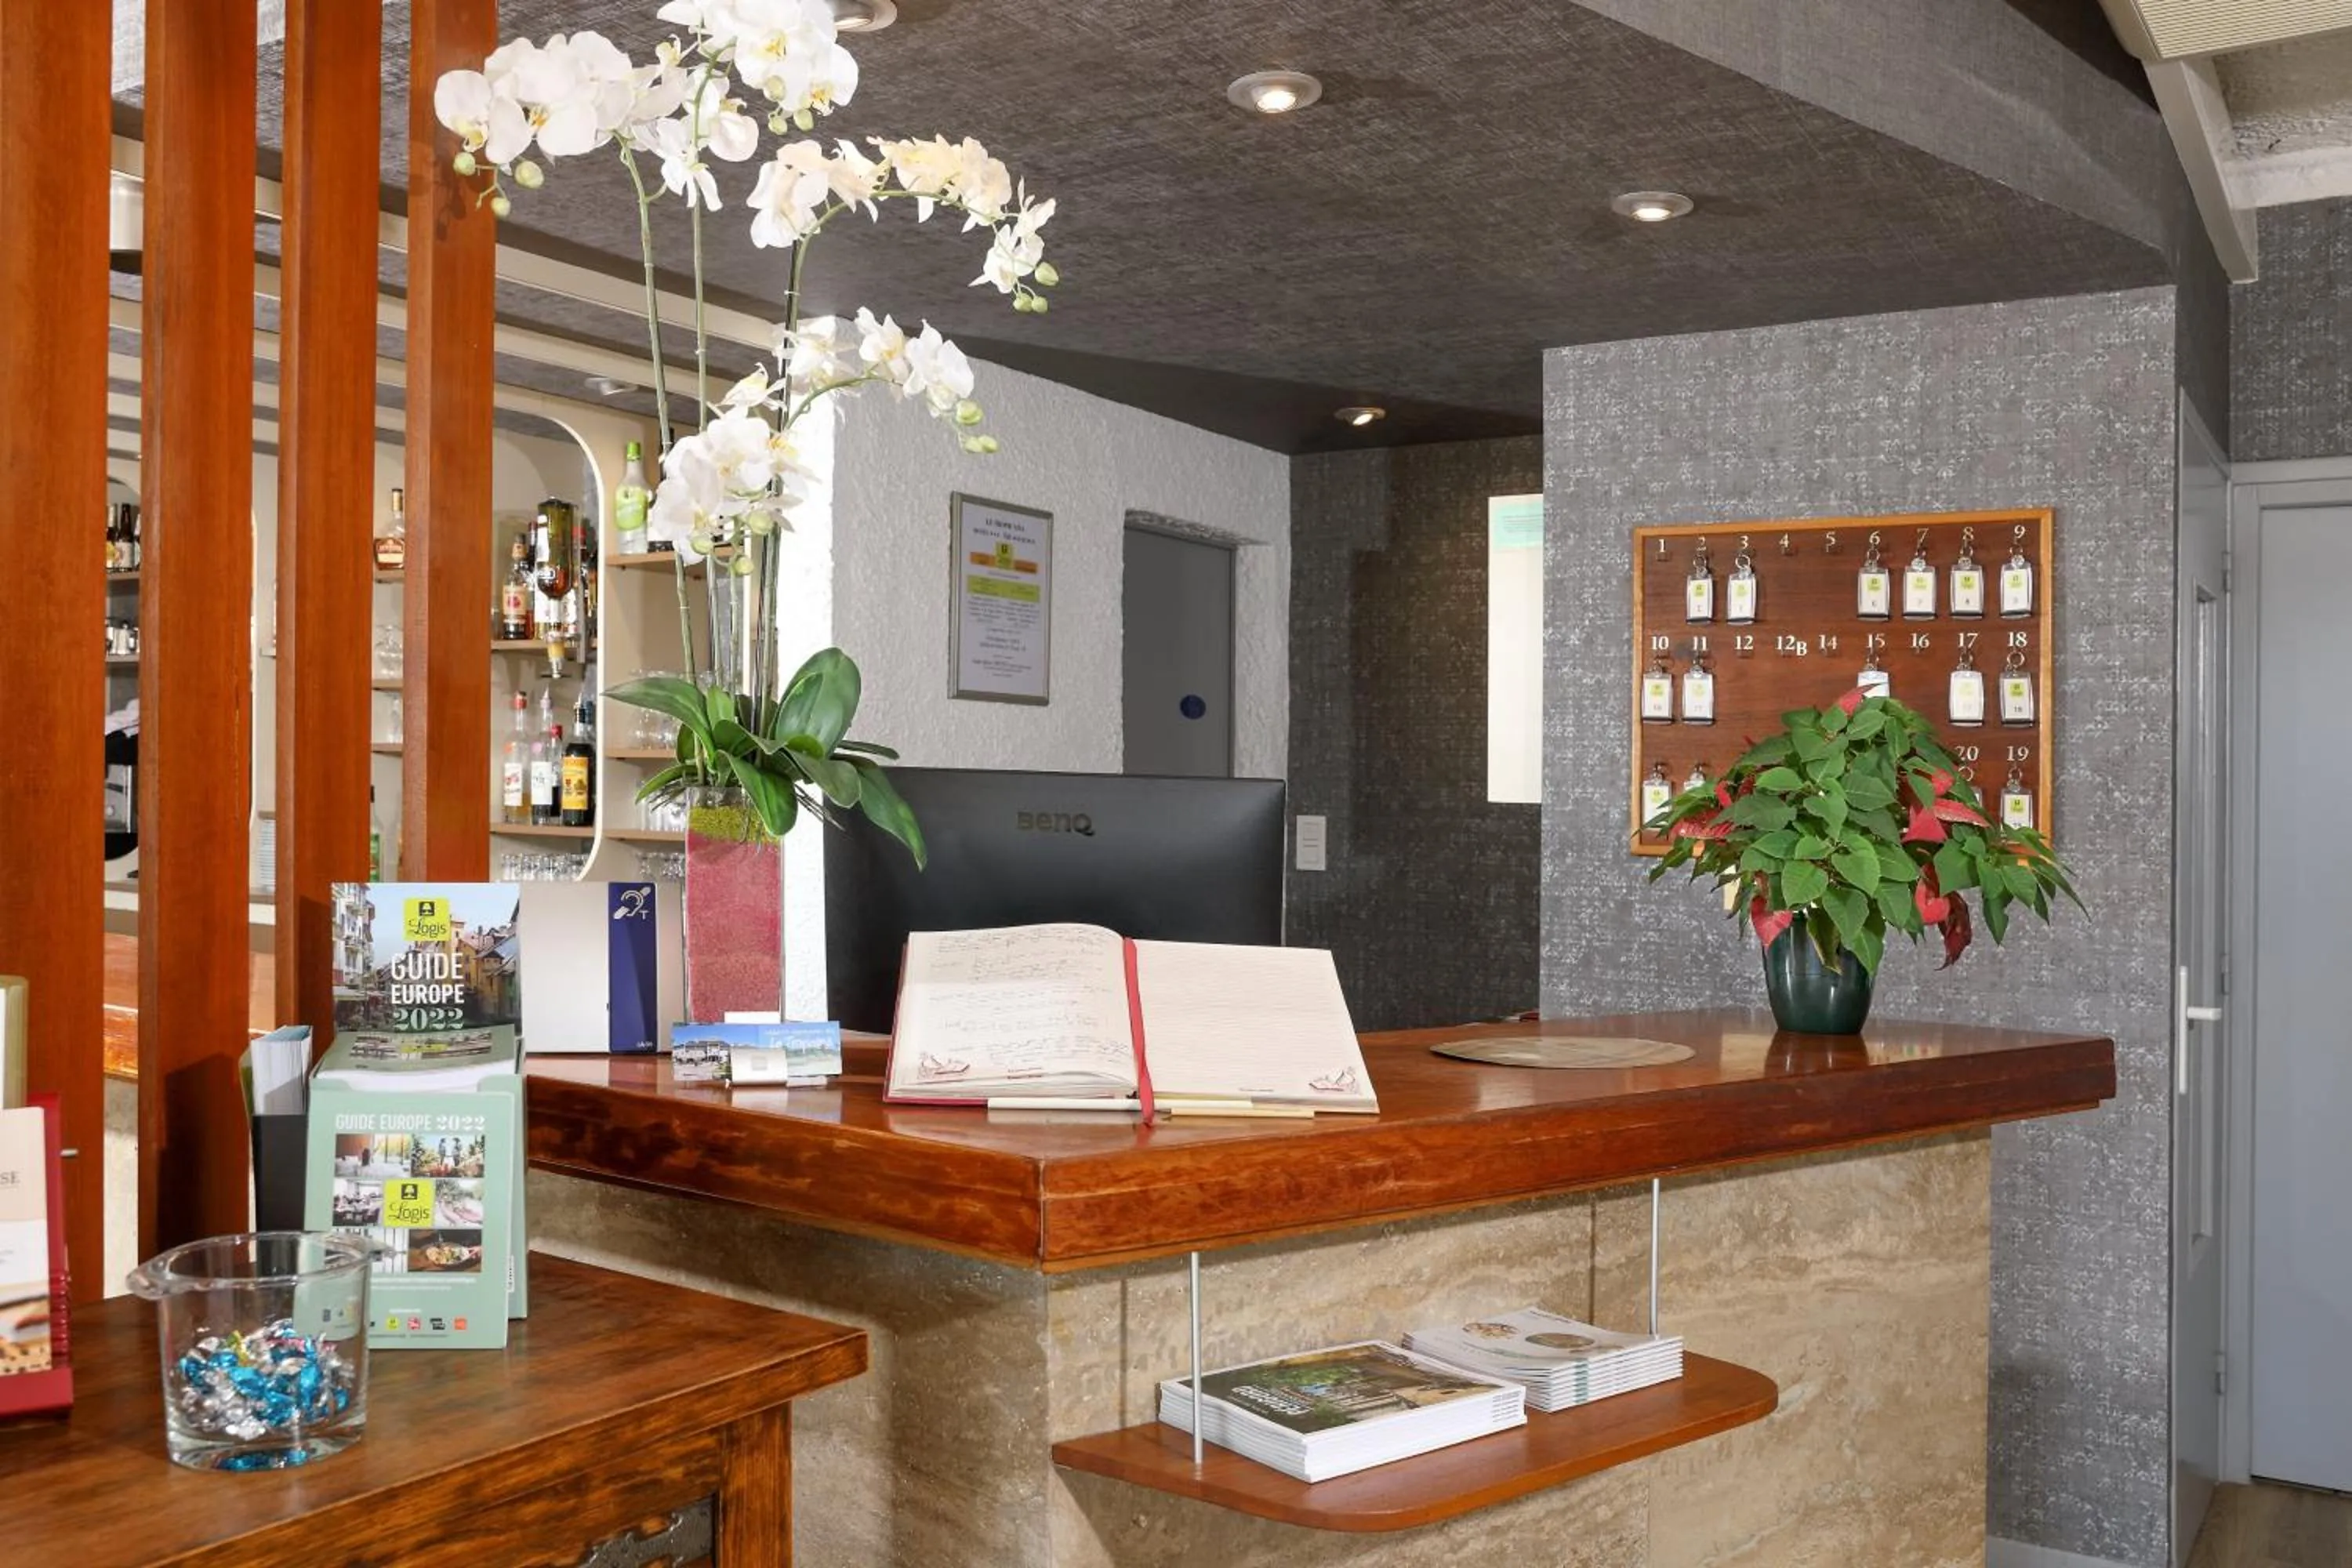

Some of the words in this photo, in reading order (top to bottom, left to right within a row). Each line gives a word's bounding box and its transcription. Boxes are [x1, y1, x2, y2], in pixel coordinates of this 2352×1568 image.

[1658, 539, 1667, 553] 1
[1696, 536, 1707, 551] 2
[1740, 535, 1749, 550] 3
[1779, 533, 1790, 548] 4
[1825, 532, 1836, 546] 5
[1868, 530, 1881, 545] 6
[1917, 528, 1929, 543] 7
[1962, 526, 1974, 540] 8
[2014, 524, 2026, 539] 9
[1651, 636, 1669, 650] 10
[1693, 636, 1708, 651] 11
[1734, 635, 1754, 650] 12
[1819, 634, 1838, 650] 14
[1867, 633, 1886, 648] 15
[1911, 633, 1930, 648] 16
[1958, 633, 1978, 648] 17
[2007, 631, 2028, 647] 18
[1955, 746, 1980, 761] 20
[2007, 746, 2030, 761] 19
[391, 953, 465, 981] GUIDE
[391, 984, 466, 1004] EUROPE
[393, 1007, 465, 1031] 2022
[335, 1113, 376, 1130] GUIDE
[379, 1114, 432, 1131] EUROPE
[436, 1115, 486, 1131] 2022
